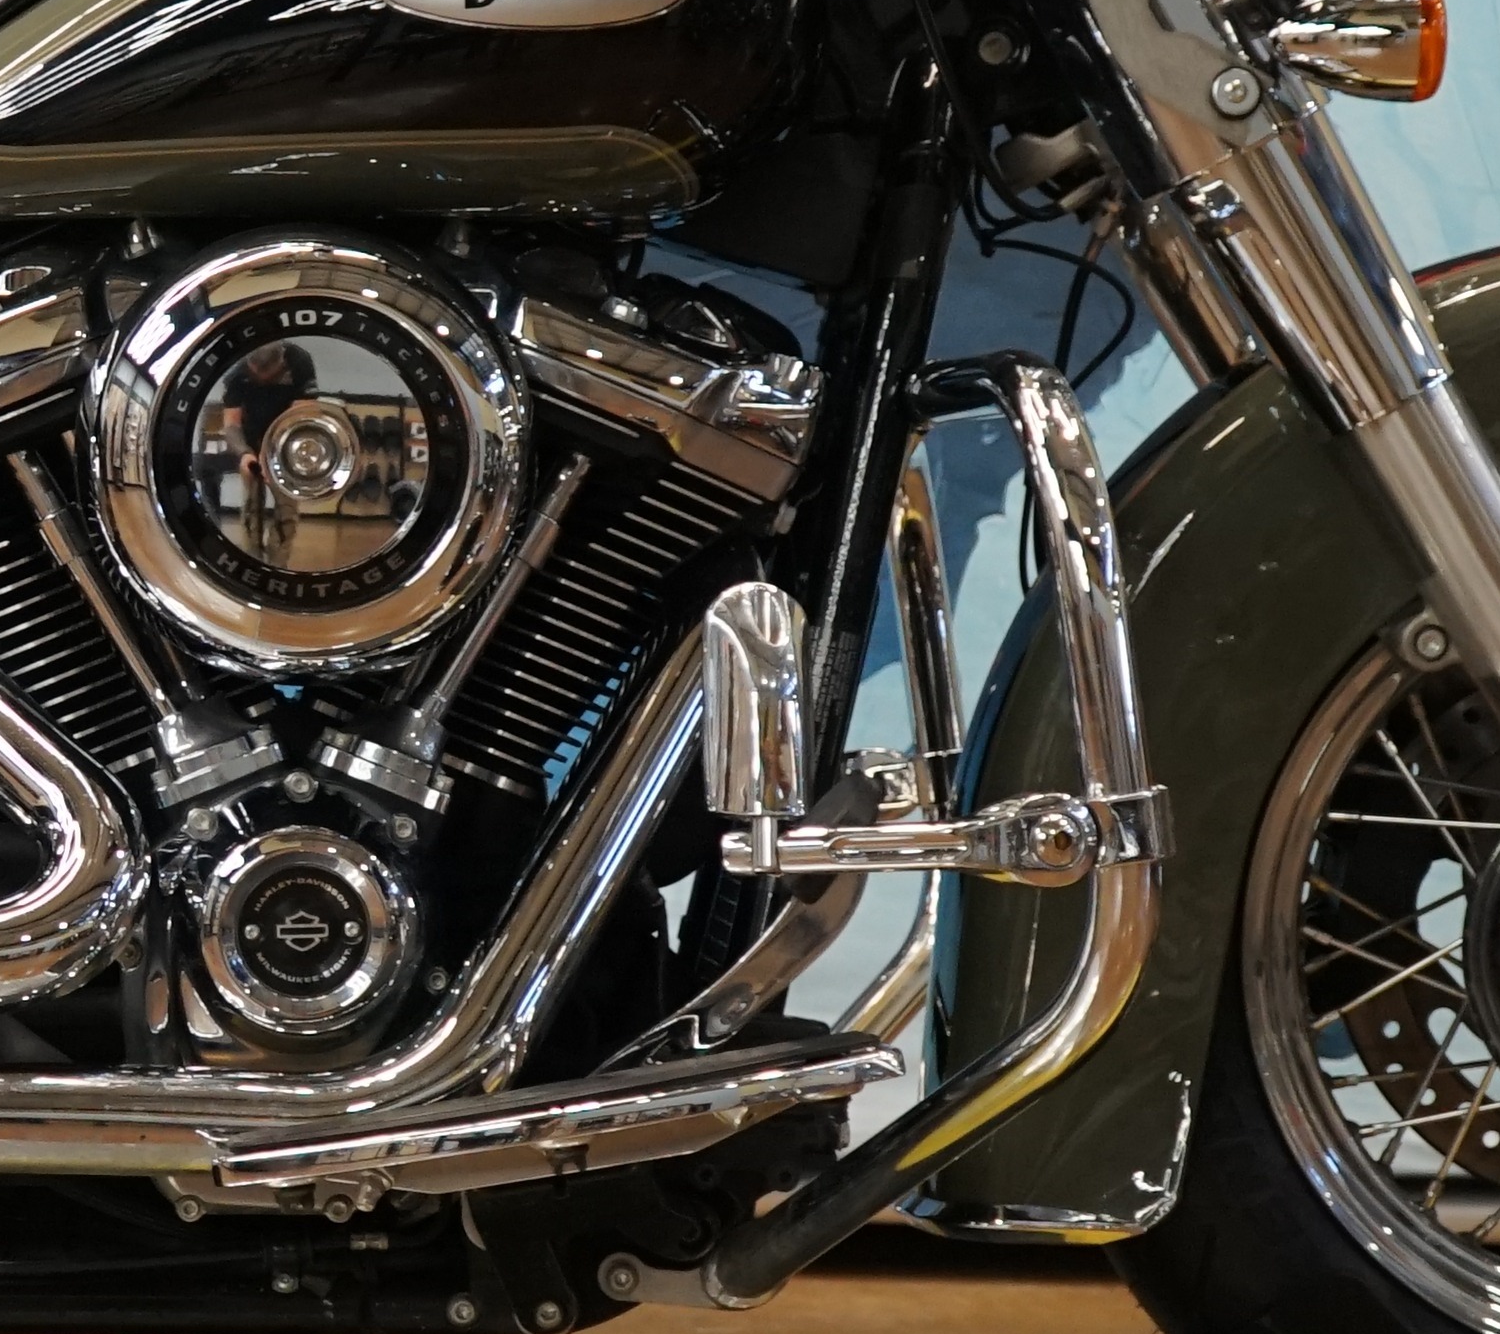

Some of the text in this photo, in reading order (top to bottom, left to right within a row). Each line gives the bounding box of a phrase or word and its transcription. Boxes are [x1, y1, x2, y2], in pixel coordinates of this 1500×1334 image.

[279, 309, 344, 328] 107
[216, 553, 406, 599] HERITAGE
[254, 877, 350, 912] HARLEY-DAVIDSON
